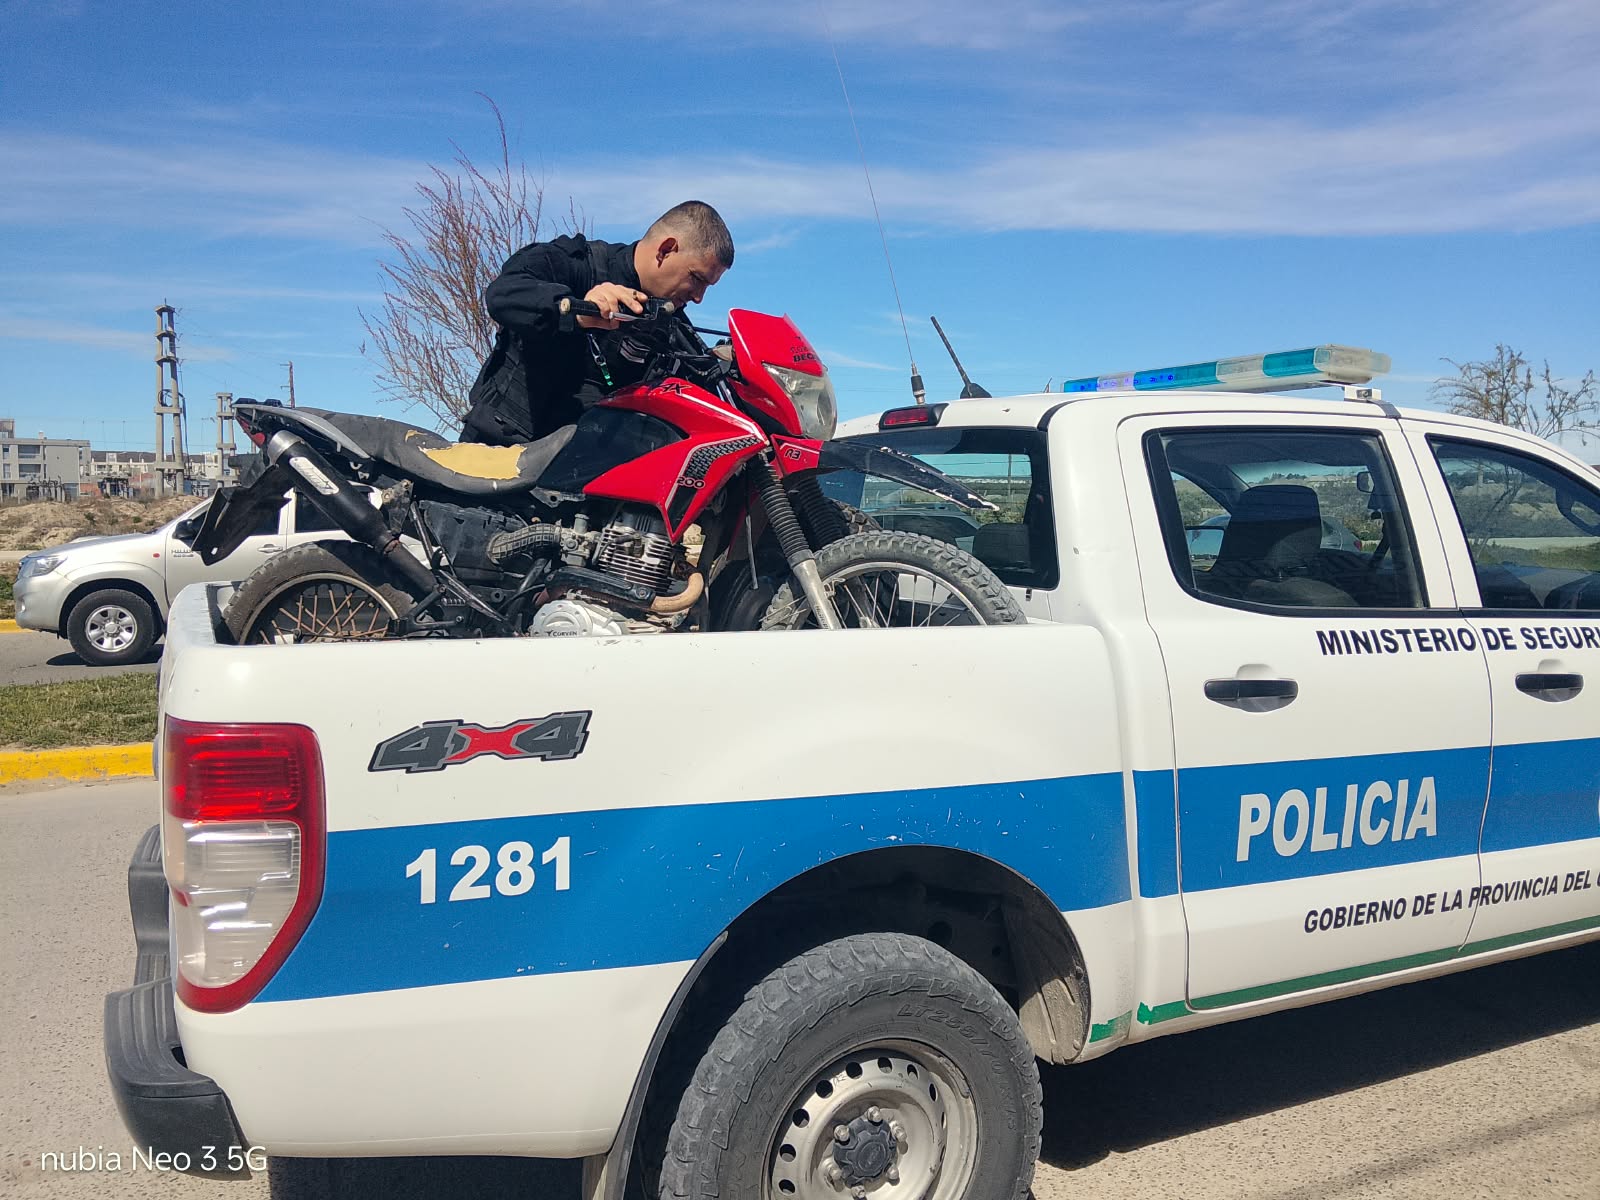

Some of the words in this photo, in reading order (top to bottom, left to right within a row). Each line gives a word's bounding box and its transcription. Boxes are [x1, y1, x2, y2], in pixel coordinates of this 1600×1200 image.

[676, 475, 706, 489] 200
[1316, 627, 1476, 655] MINISTERIO
[1480, 627, 1517, 651] DE
[1236, 776, 1438, 863] POLICIA
[406, 836, 571, 905] 1281
[1304, 897, 1407, 933] GOBIERNO
[1411, 893, 1437, 917] DE
[1440, 889, 1463, 912] LA
[1468, 875, 1558, 908] PROVINCIA
[1562, 869, 1592, 893] DEL
